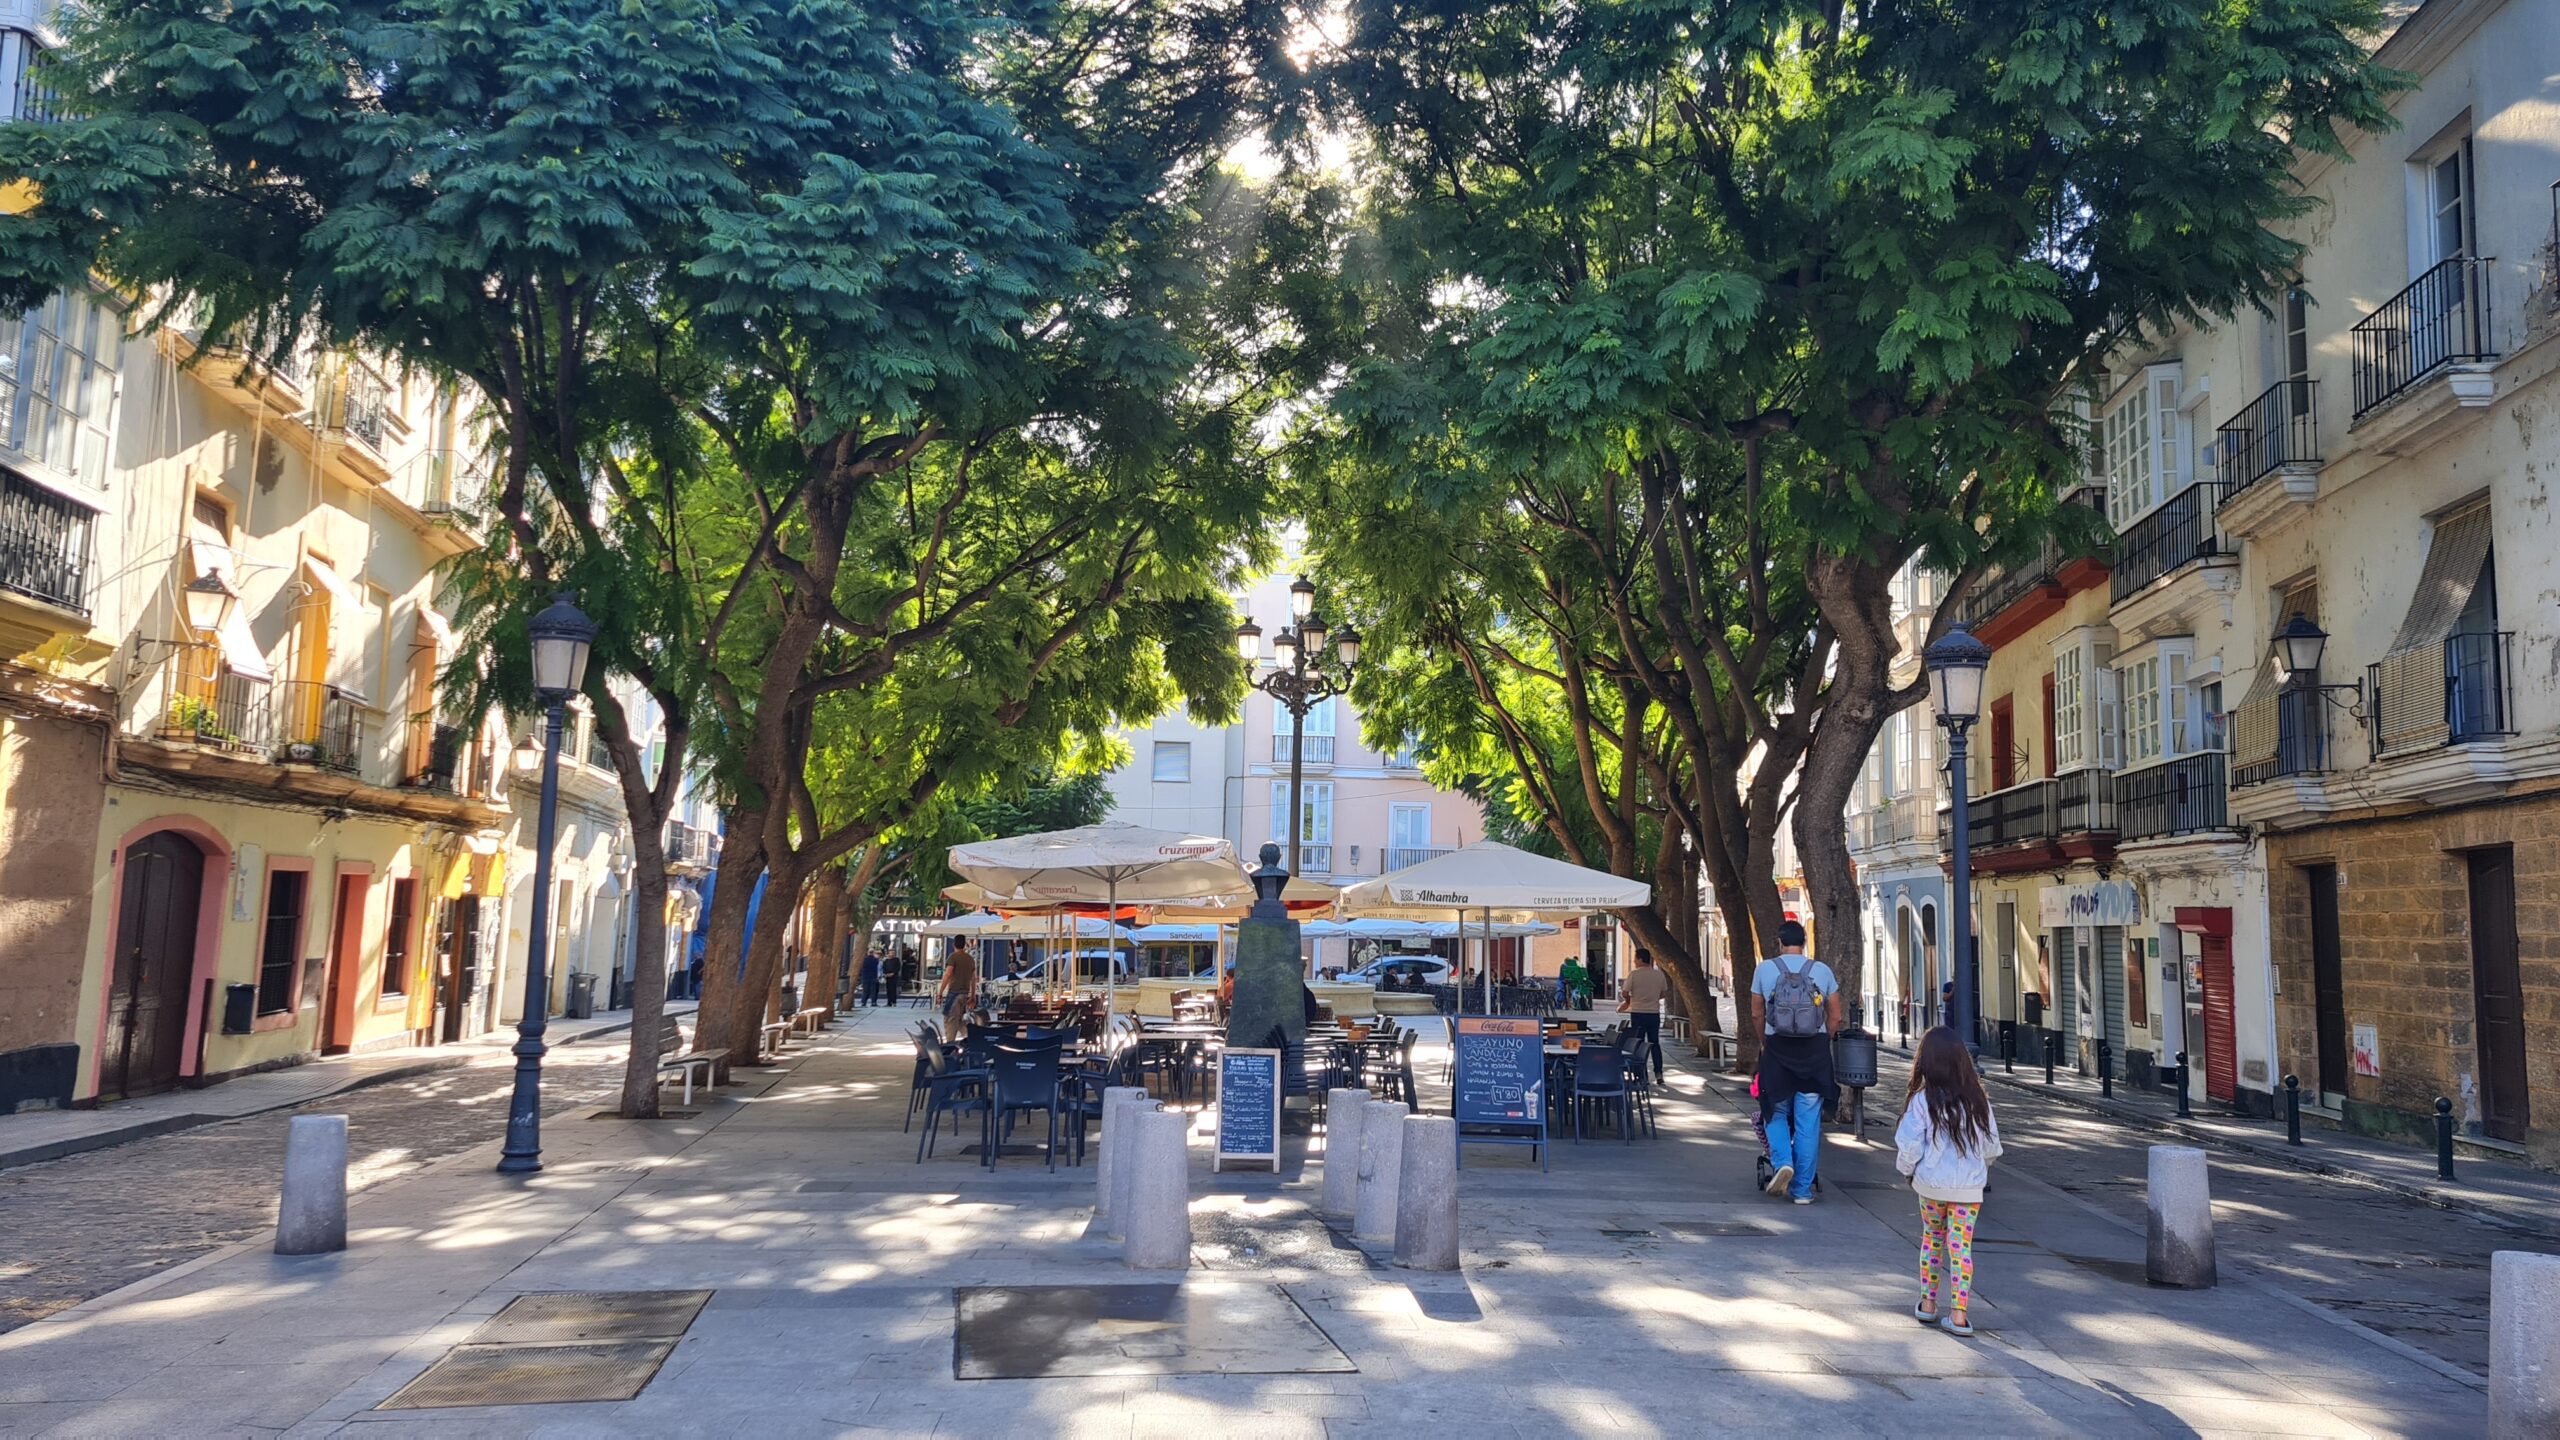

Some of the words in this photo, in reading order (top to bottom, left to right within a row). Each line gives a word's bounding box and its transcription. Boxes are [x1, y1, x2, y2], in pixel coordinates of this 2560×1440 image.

[1158, 845, 1215, 855] Cruzcampo
[1416, 889, 1469, 904] Alhambra
[1533, 896, 1562, 905] CERVEZA
[1562, 896, 1584, 904] HECHA
[1585, 896, 1597, 904] SIN
[1169, 932, 1203, 940] Sandevid
[1470, 1049, 1517, 1060] ANDALUZ
